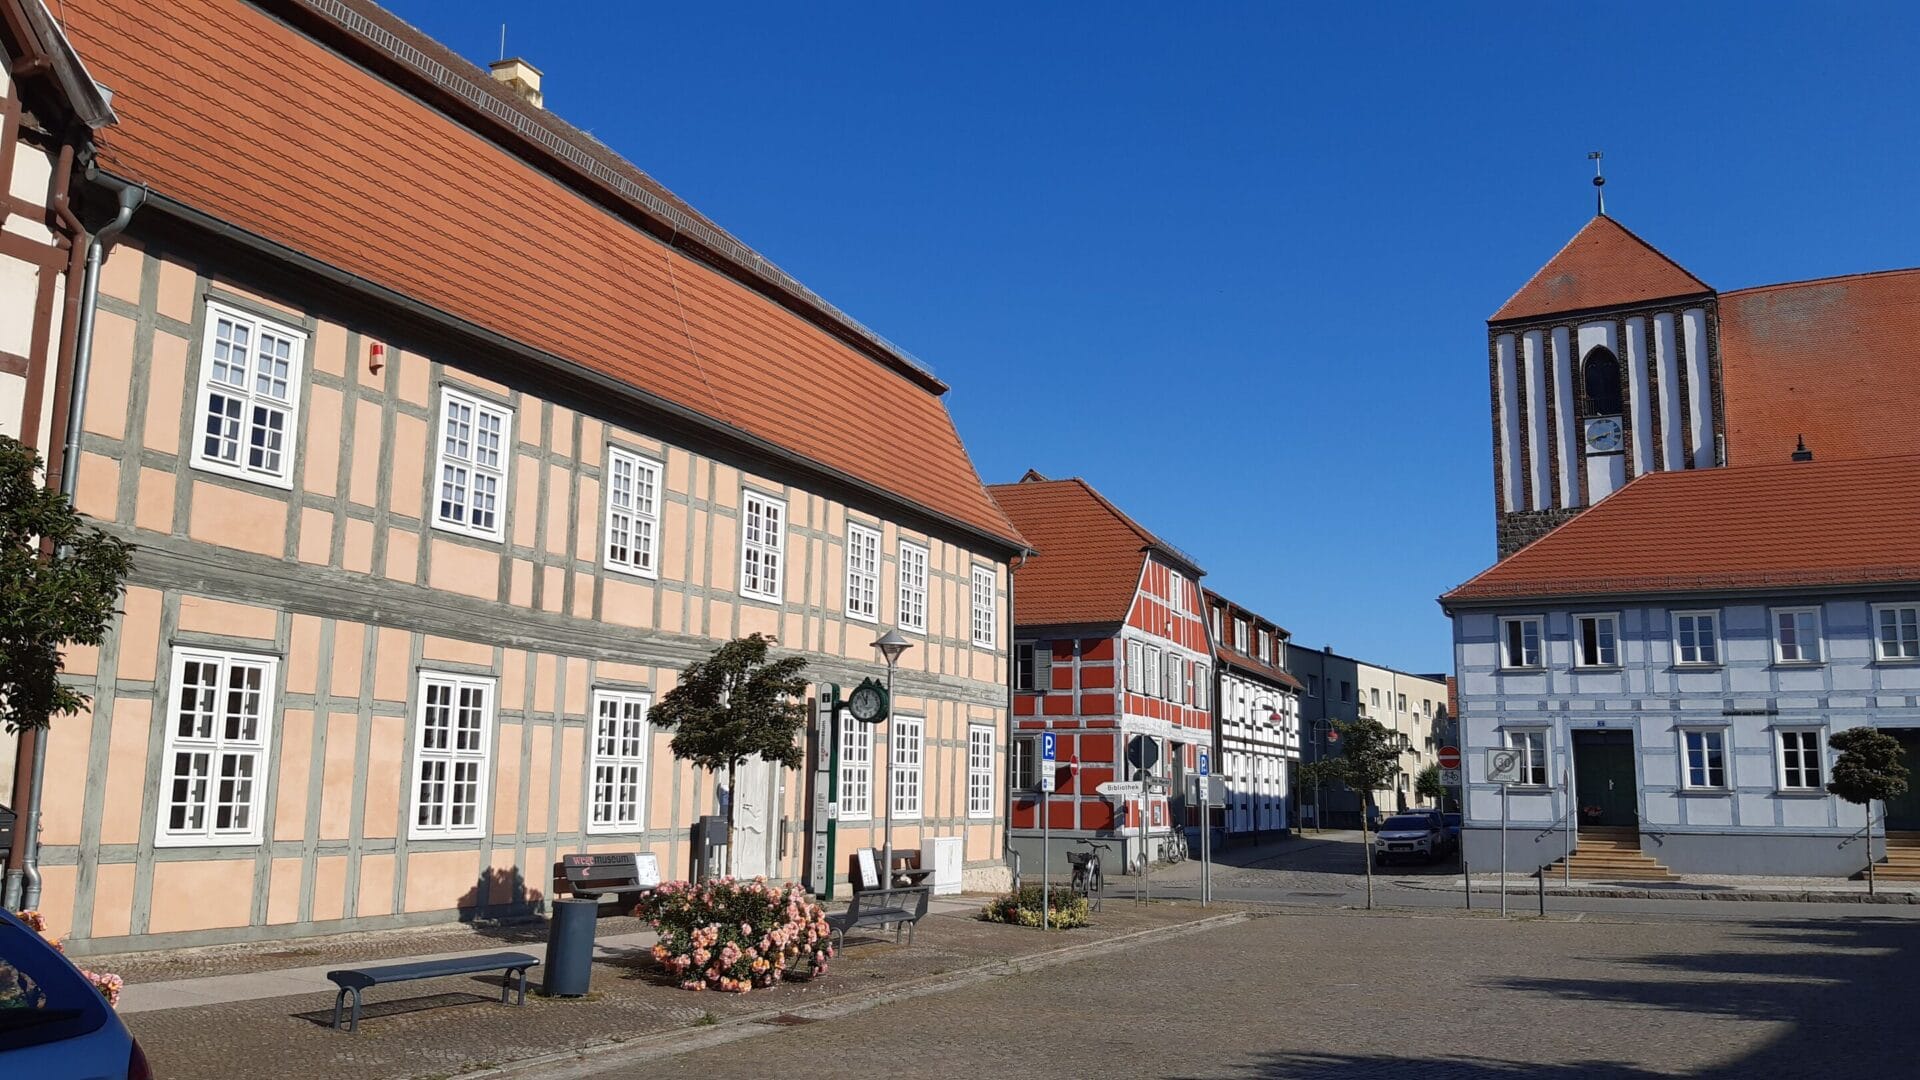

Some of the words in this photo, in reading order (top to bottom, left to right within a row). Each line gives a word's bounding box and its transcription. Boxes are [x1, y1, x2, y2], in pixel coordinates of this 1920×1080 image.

[1045, 735, 1053, 756] P
[1201, 756, 1206, 772] P
[1498, 757, 1510, 768] 30
[572, 855, 629, 866] wegemuseum
